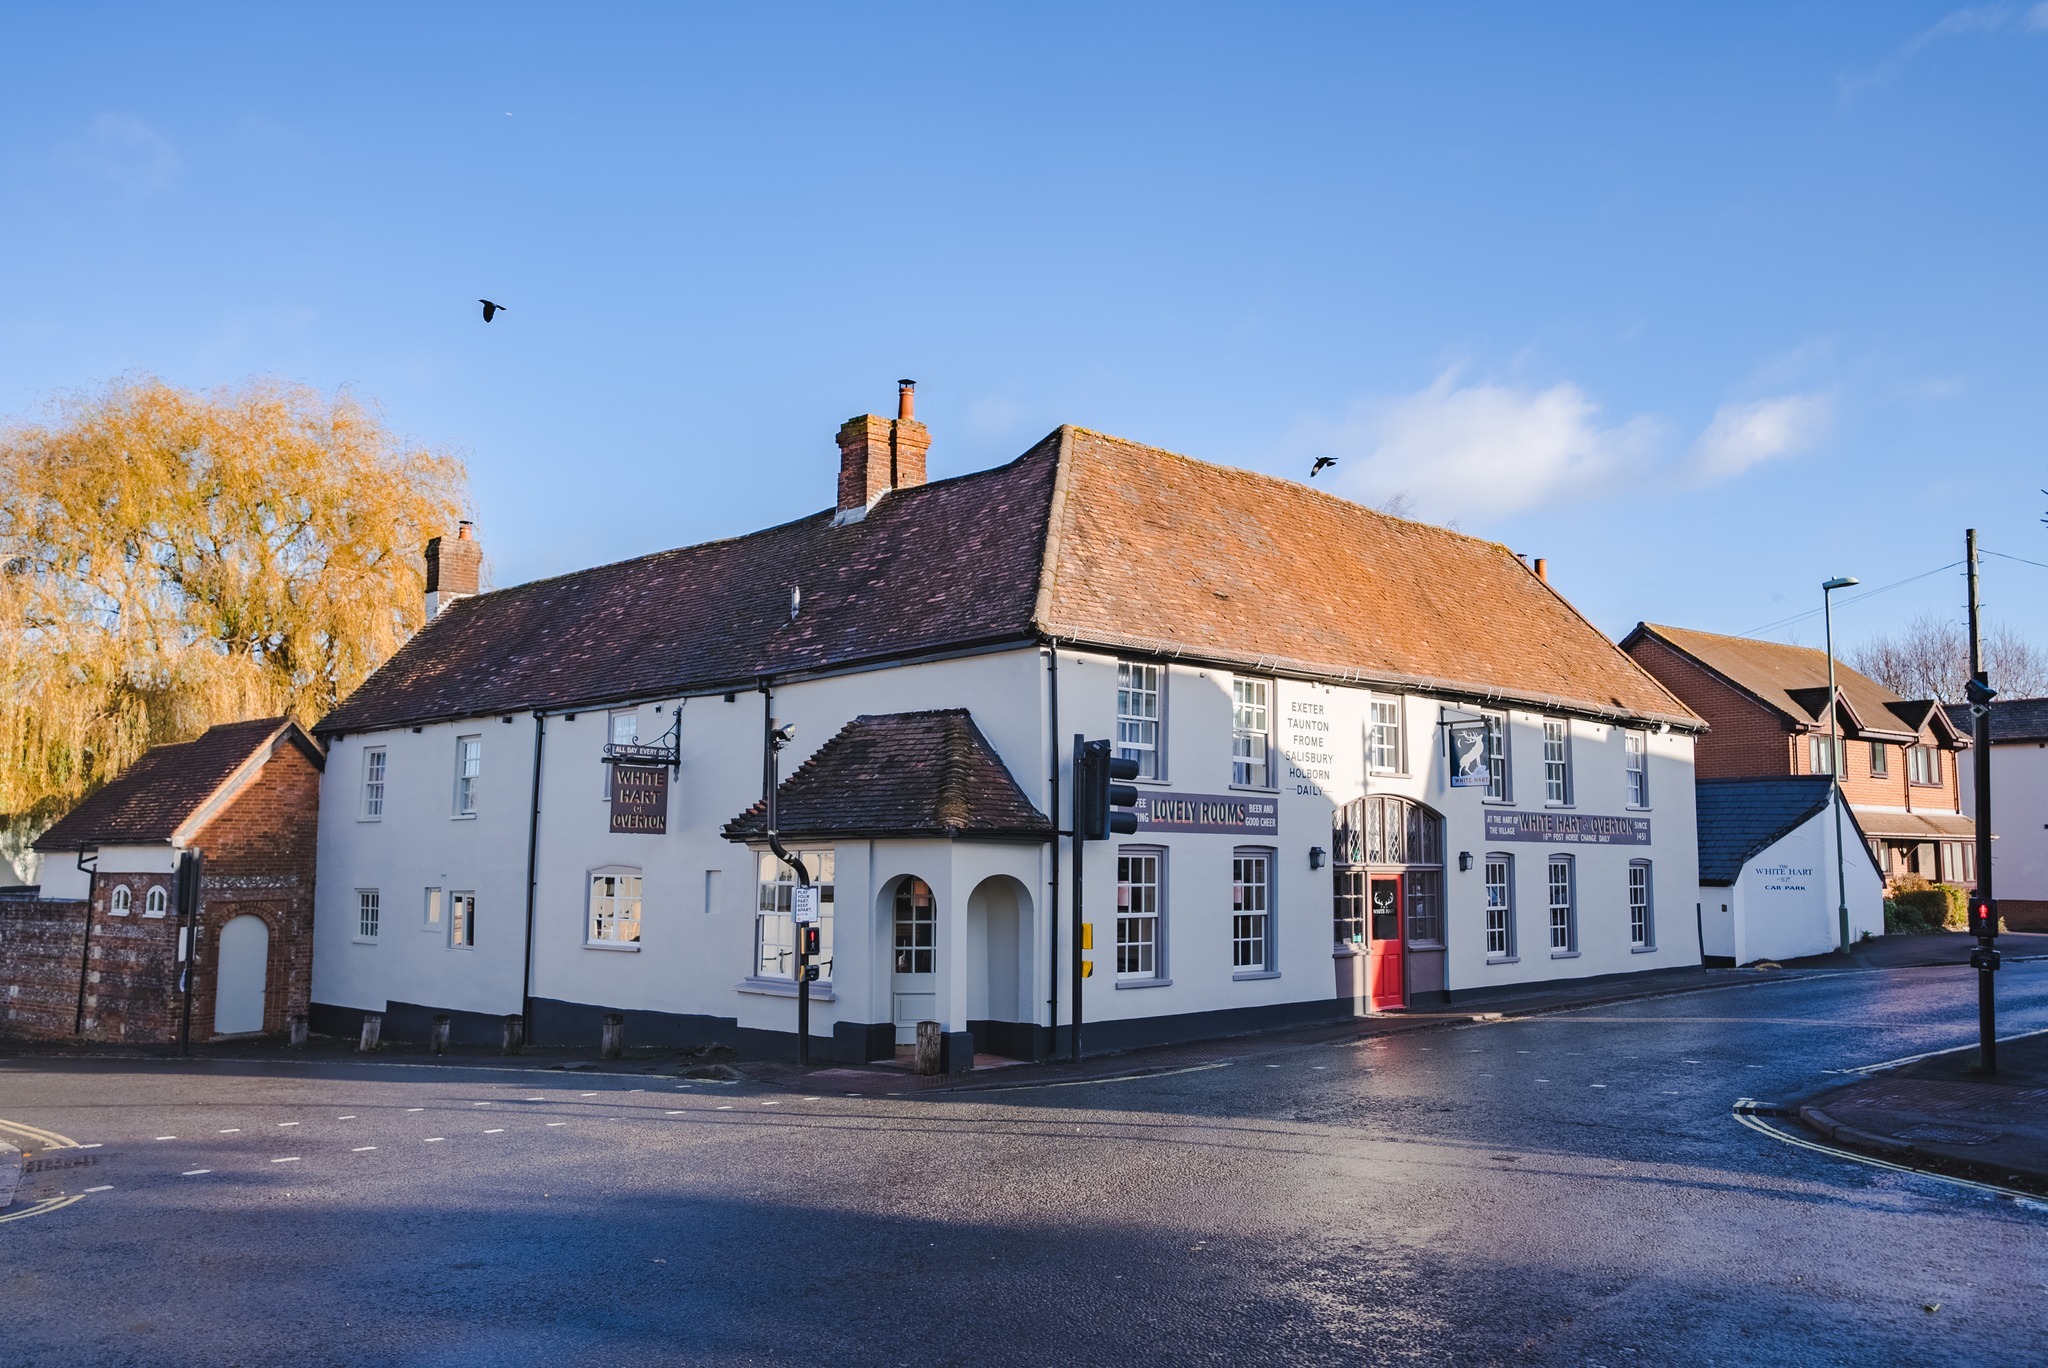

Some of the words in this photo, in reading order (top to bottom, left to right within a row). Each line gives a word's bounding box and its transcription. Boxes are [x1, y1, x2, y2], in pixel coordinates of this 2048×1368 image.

[1291, 701, 1324, 715] EXETER
[1287, 717, 1329, 732] TAUNTON
[1293, 734, 1324, 748] FROME
[627, 746, 638, 754] DAY
[639, 747, 657, 755] EVERY
[1285, 750, 1334, 765] SALISBURY
[617, 769, 665, 787] WHITE
[1289, 767, 1330, 780] HOLBORN
[1453, 776, 1472, 784] WHITE
[1296, 784, 1323, 796] DAILY
[619, 788, 661, 805] HART
[633, 804, 645, 813] OF
[1151, 799, 1197, 824] LOVELY
[1199, 802, 1246, 826] ROOMS
[1248, 803, 1262, 814] BEER
[1263, 804, 1274, 814] AND
[612, 813, 665, 829] OVERTON
[1245, 816, 1260, 827] GOOD
[1260, 817, 1276, 828] CHEER
[1486, 815, 1492, 823] AT
[1493, 815, 1502, 824] THE
[1502, 816, 1513, 824] HART
[1513, 816, 1519, 824] OF
[1519, 813, 1553, 833] WHITE
[1556, 815, 1582, 833] HART
[1591, 817, 1633, 835] OVERTON
[1634, 821, 1648, 830] SINCE
[1489, 826, 1498, 835] THE
[1498, 826, 1516, 835] VILLAGE
[1636, 832, 1647, 840] 1451
[1553, 833, 1564, 841] POST
[1565, 833, 1579, 841] HORSE
[1580, 834, 1597, 842] CHANGE
[1598, 834, 1610, 842] DAILY
[1788, 868, 1814, 876] HART
